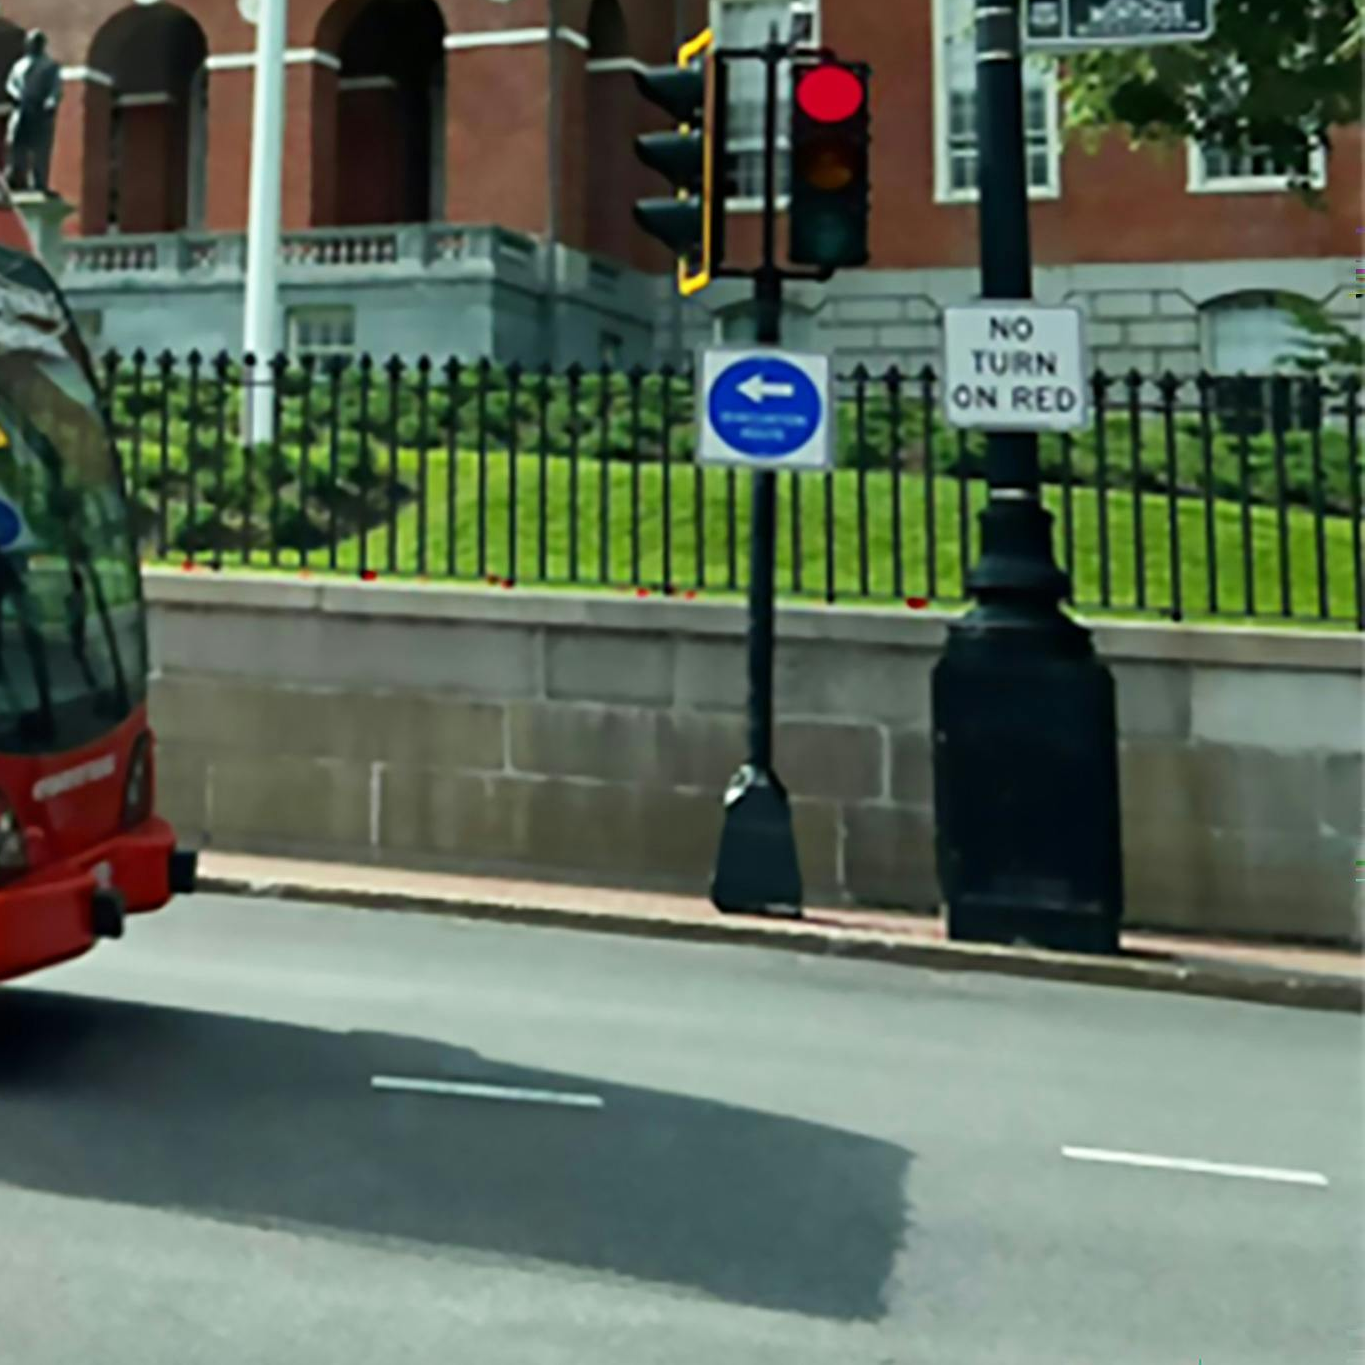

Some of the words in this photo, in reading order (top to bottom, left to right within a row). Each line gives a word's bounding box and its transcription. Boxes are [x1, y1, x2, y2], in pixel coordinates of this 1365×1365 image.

[989, 316, 1034, 342] NO
[972, 349, 1057, 376] TURN
[953, 384, 997, 409] ON
[1012, 385, 1076, 413] RED
